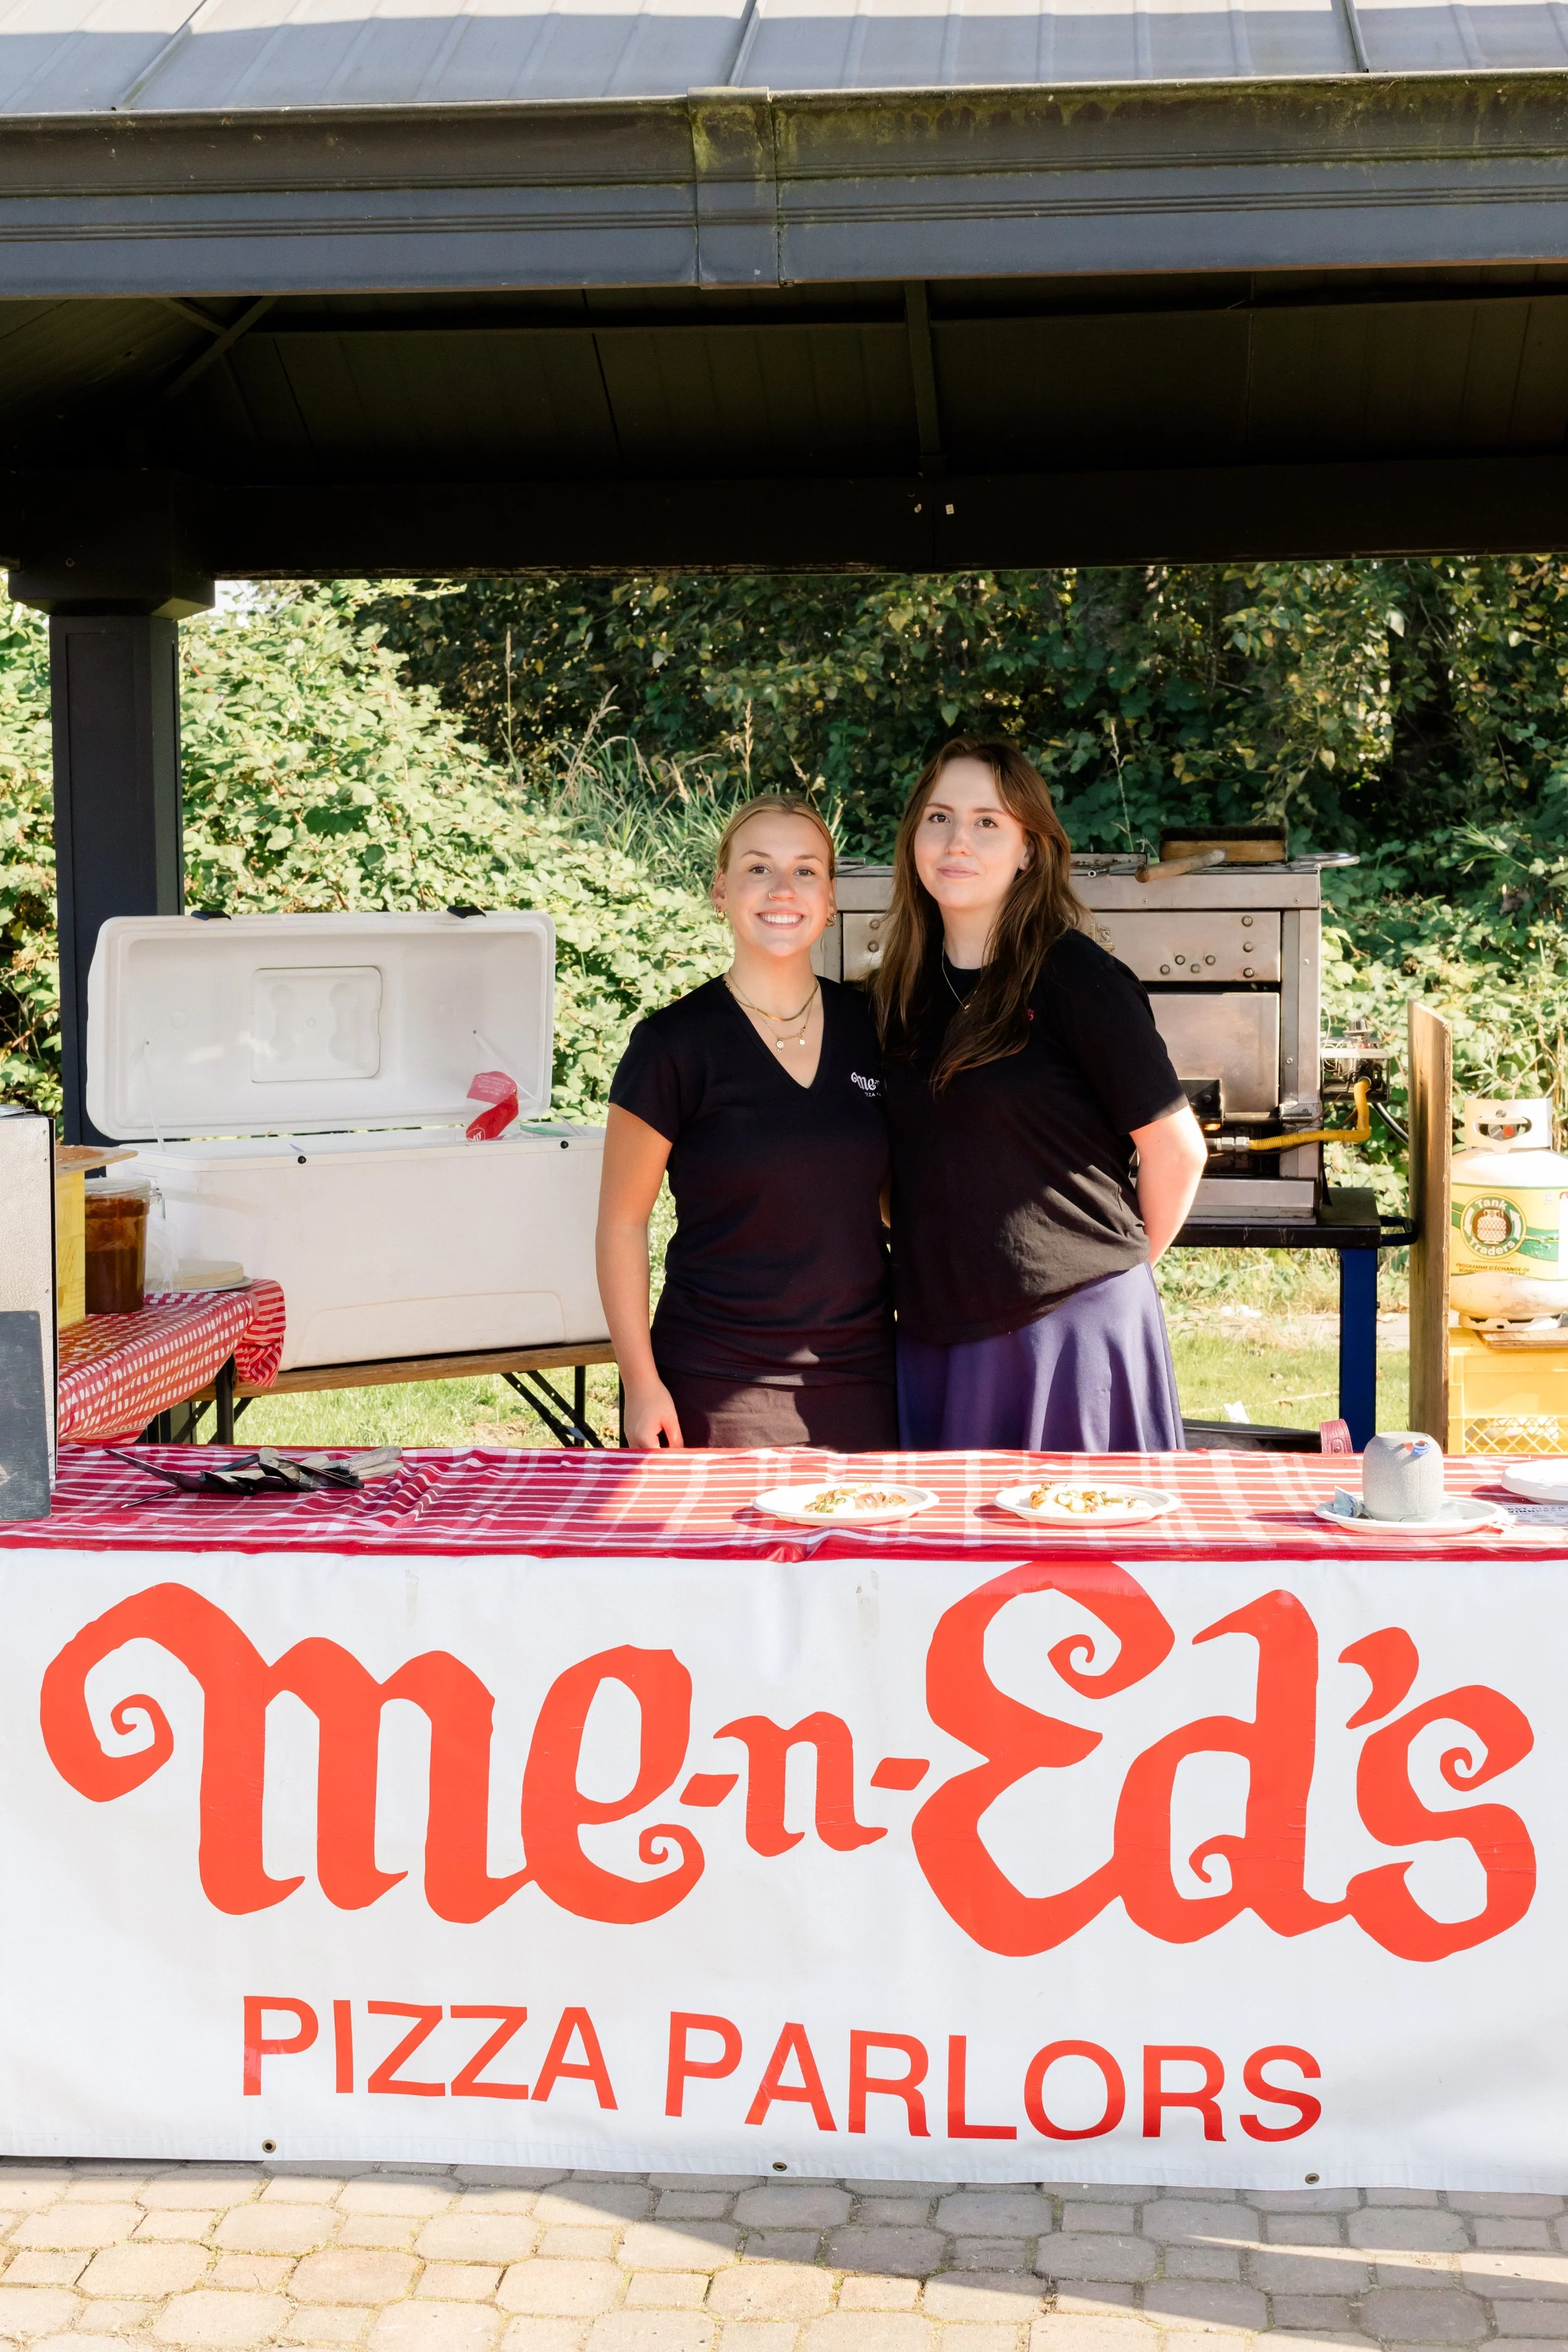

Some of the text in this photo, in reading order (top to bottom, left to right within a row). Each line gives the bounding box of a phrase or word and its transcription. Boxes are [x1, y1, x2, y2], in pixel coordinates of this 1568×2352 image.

[1475, 1199, 1508, 1210] Tank
[1469, 1237, 1516, 1256] Traders
[243, 1996, 1321, 2141] PIZZA PARLORS
